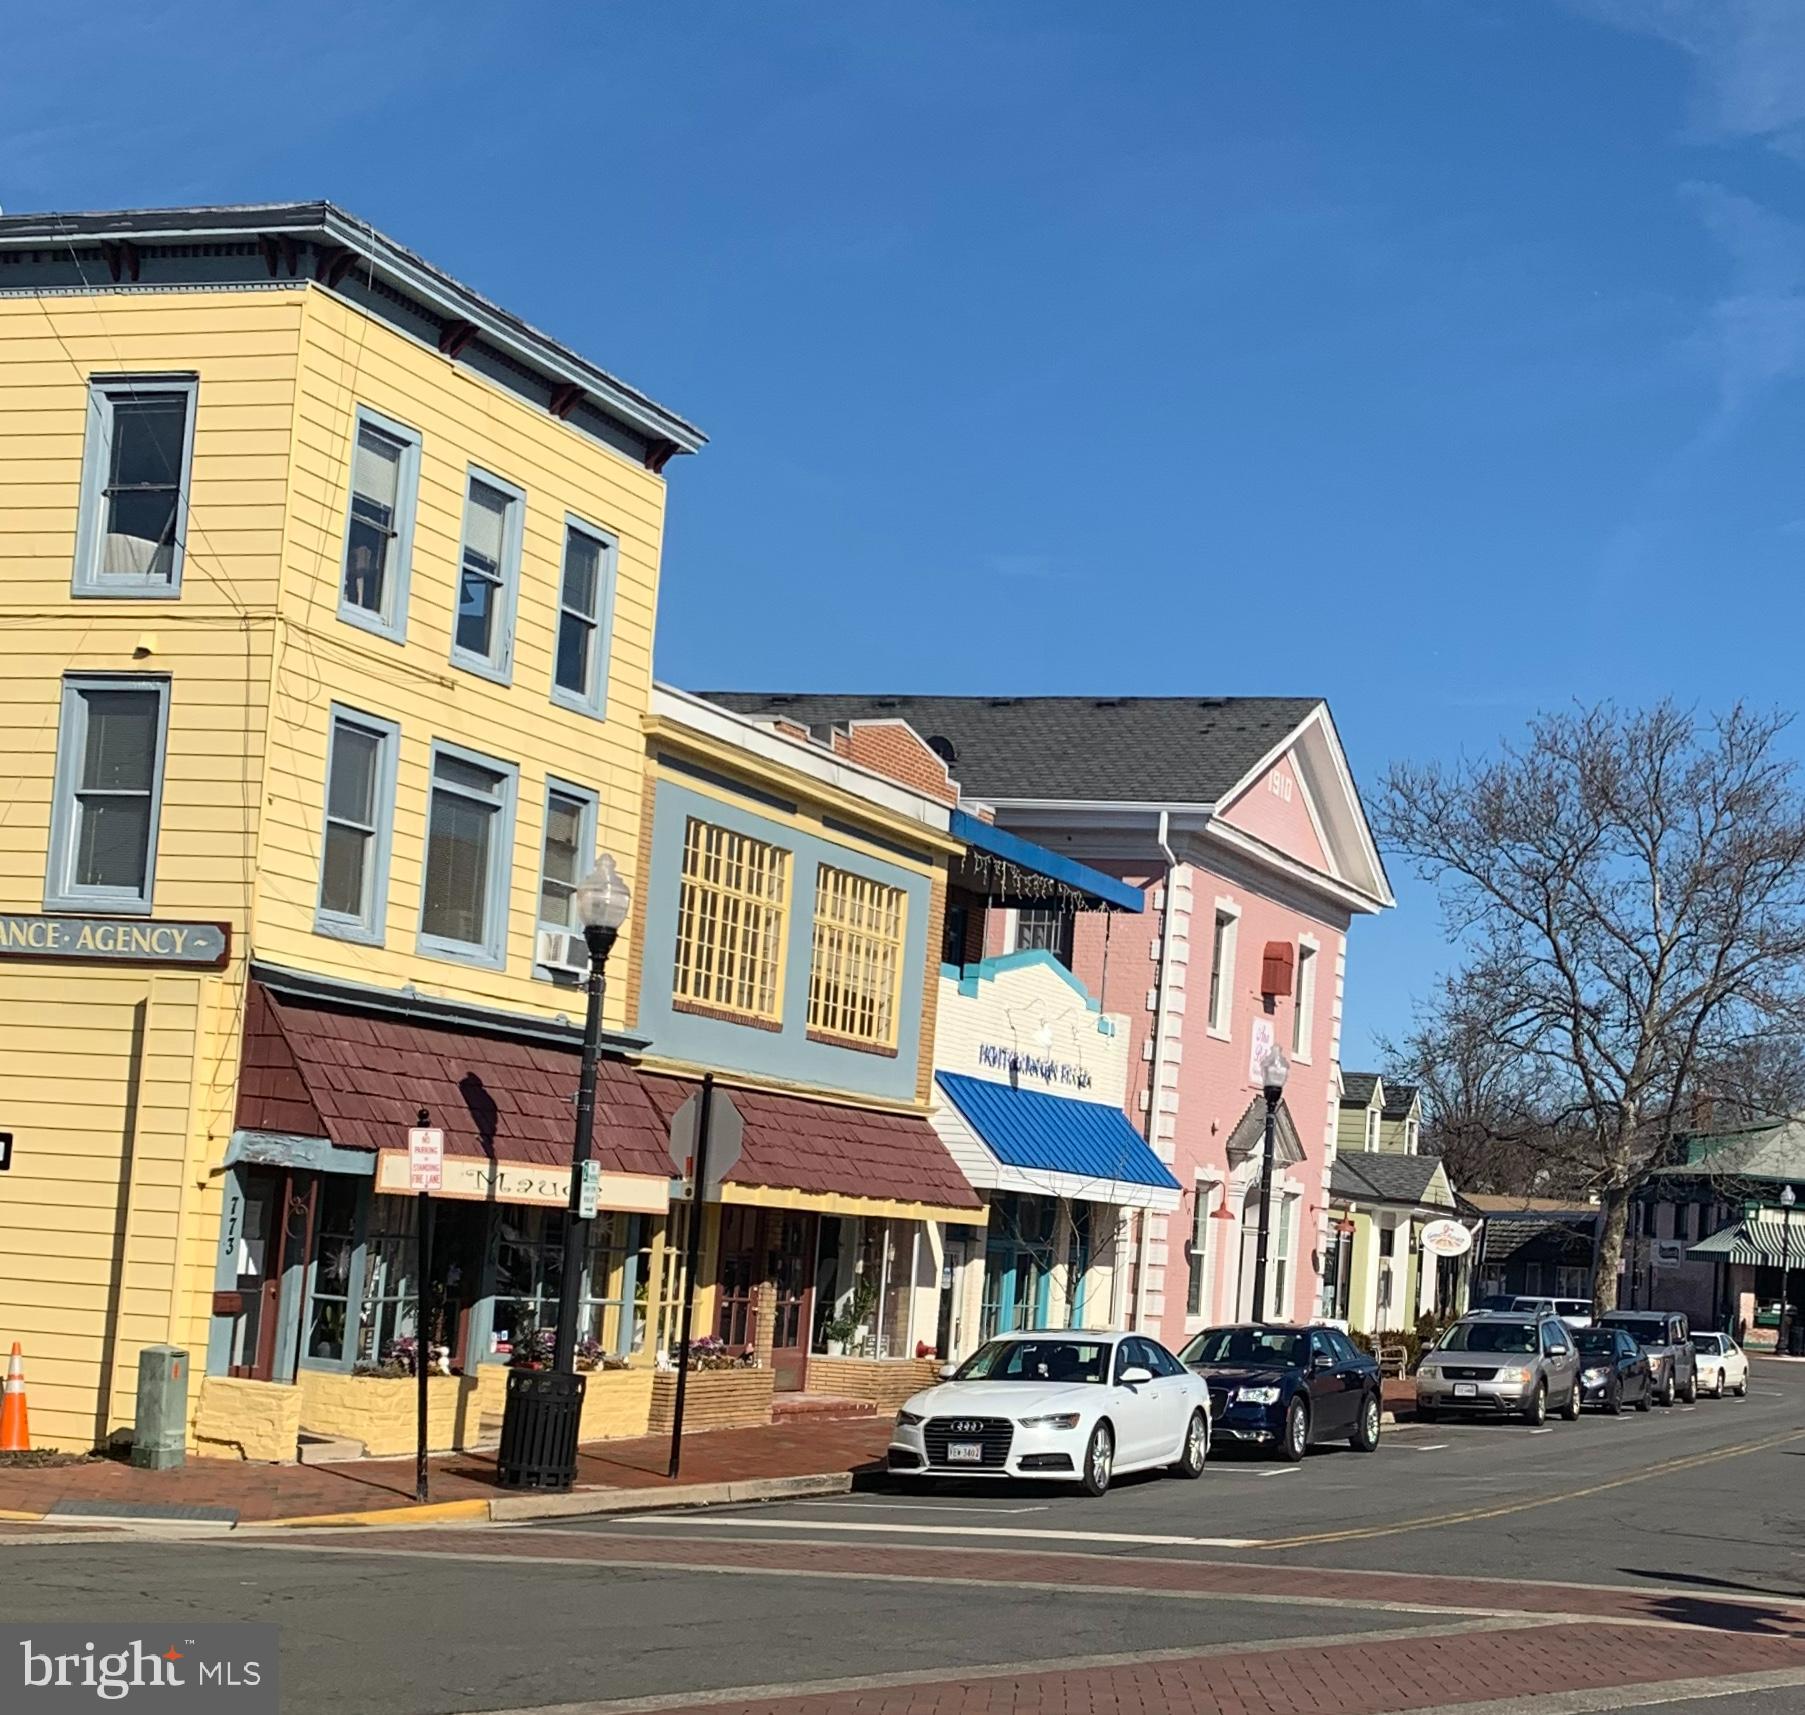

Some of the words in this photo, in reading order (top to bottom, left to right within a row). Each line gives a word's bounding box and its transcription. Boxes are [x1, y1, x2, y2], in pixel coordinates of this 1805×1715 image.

[1268, 769, 1292, 804] 1910
[76, 925, 189, 954] AGENCY
[226, 1196, 240, 1255] 773
